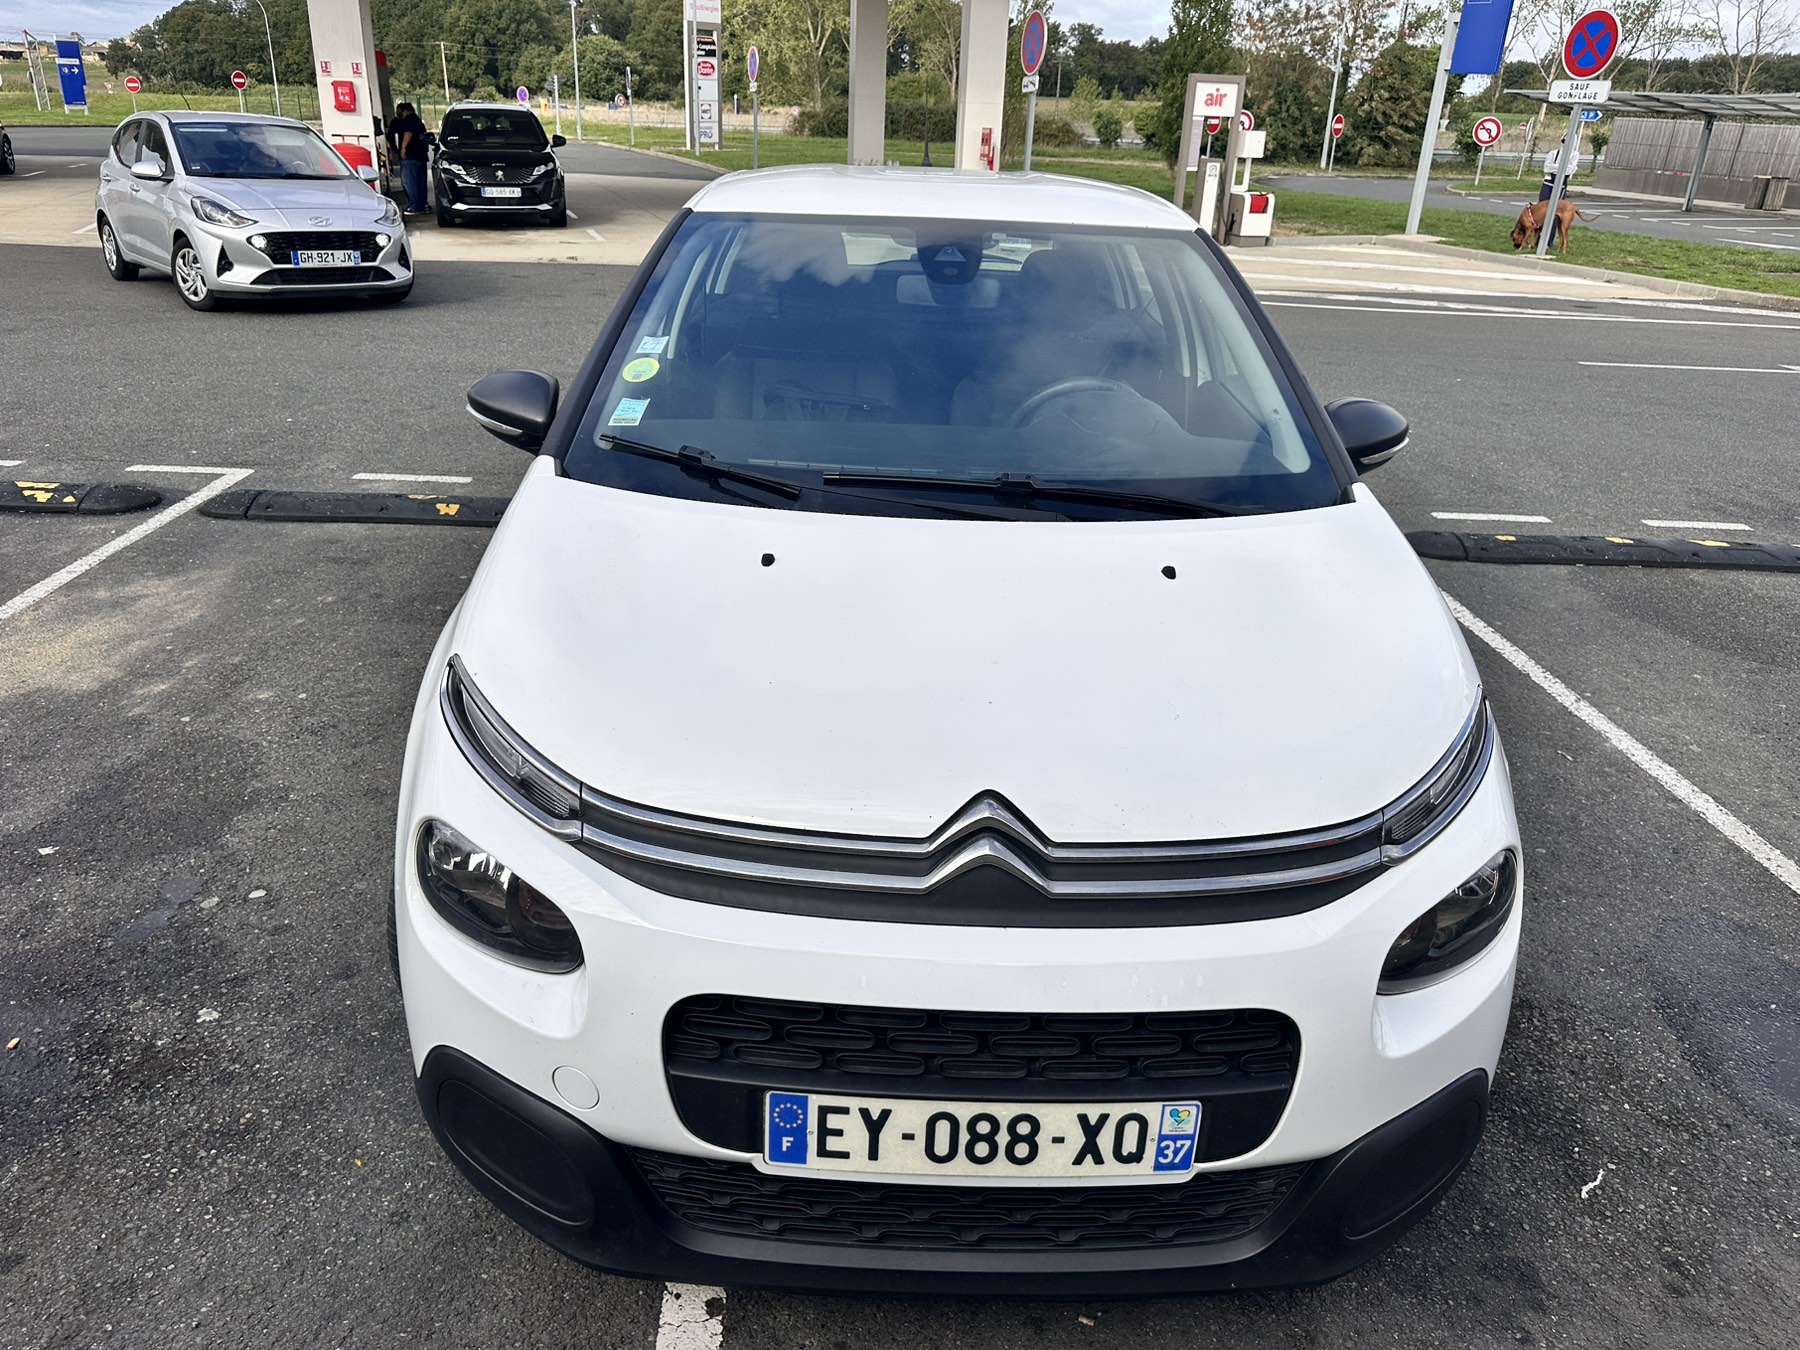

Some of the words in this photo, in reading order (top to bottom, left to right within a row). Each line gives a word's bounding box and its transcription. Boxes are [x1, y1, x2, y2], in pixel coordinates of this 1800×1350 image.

[1204, 87, 1228, 107] air
[1557, 91, 1598, 100] GONFLAGE
[300, 251, 353, 263] GH-921-JX
[781, 1136, 794, 1152] F
[816, 1104, 1149, 1166] EY-088-XQ
[1157, 1140, 1192, 1164] 37
